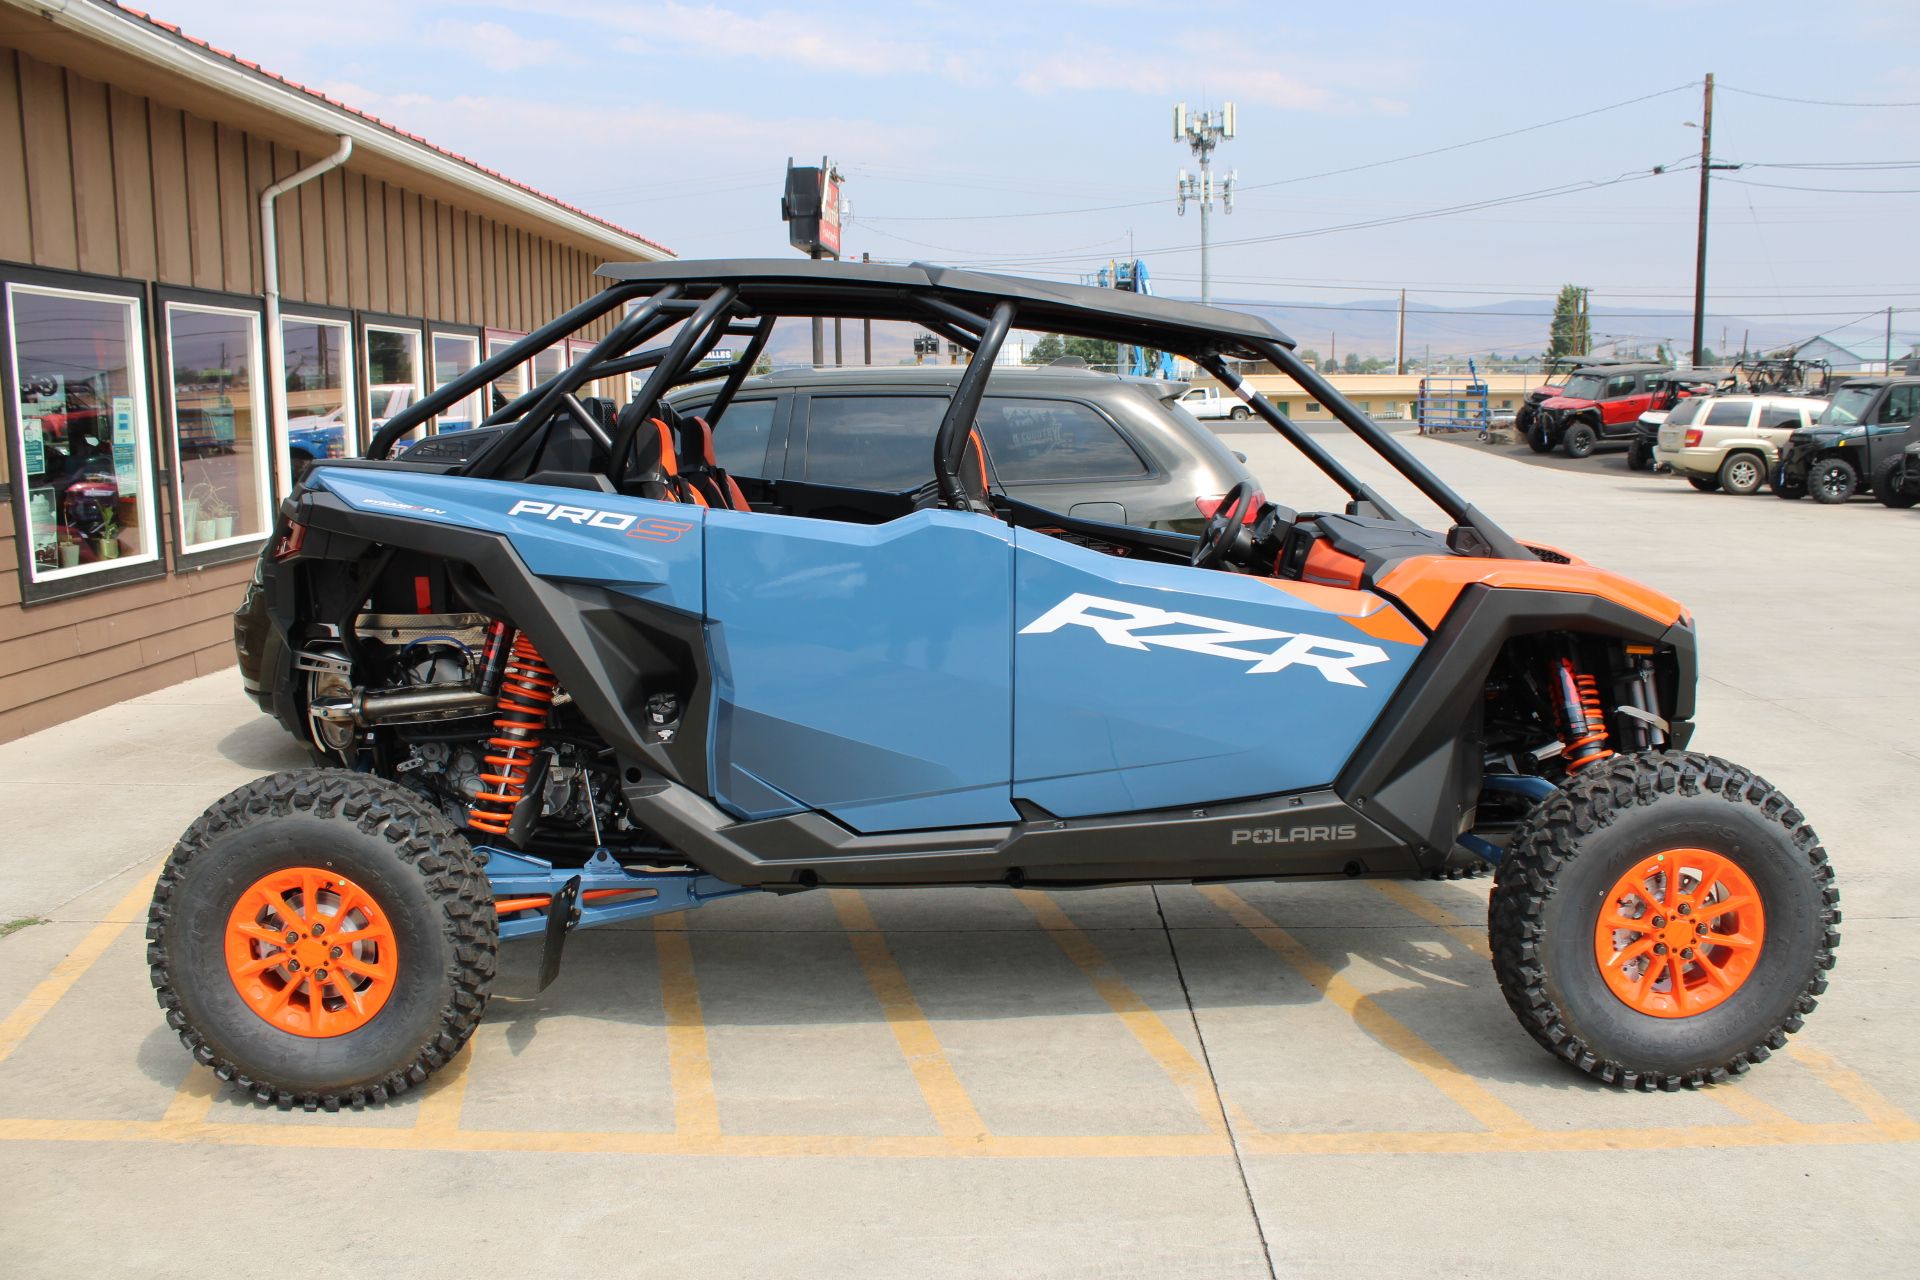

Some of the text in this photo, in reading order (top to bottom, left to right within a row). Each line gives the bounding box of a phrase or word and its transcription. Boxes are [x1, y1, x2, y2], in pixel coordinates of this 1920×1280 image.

[704, 350, 731, 359] ALLES
[508, 499, 694, 543] PRO S
[1018, 592, 1390, 688] RZR
[1231, 823, 1357, 845] POLARIS
